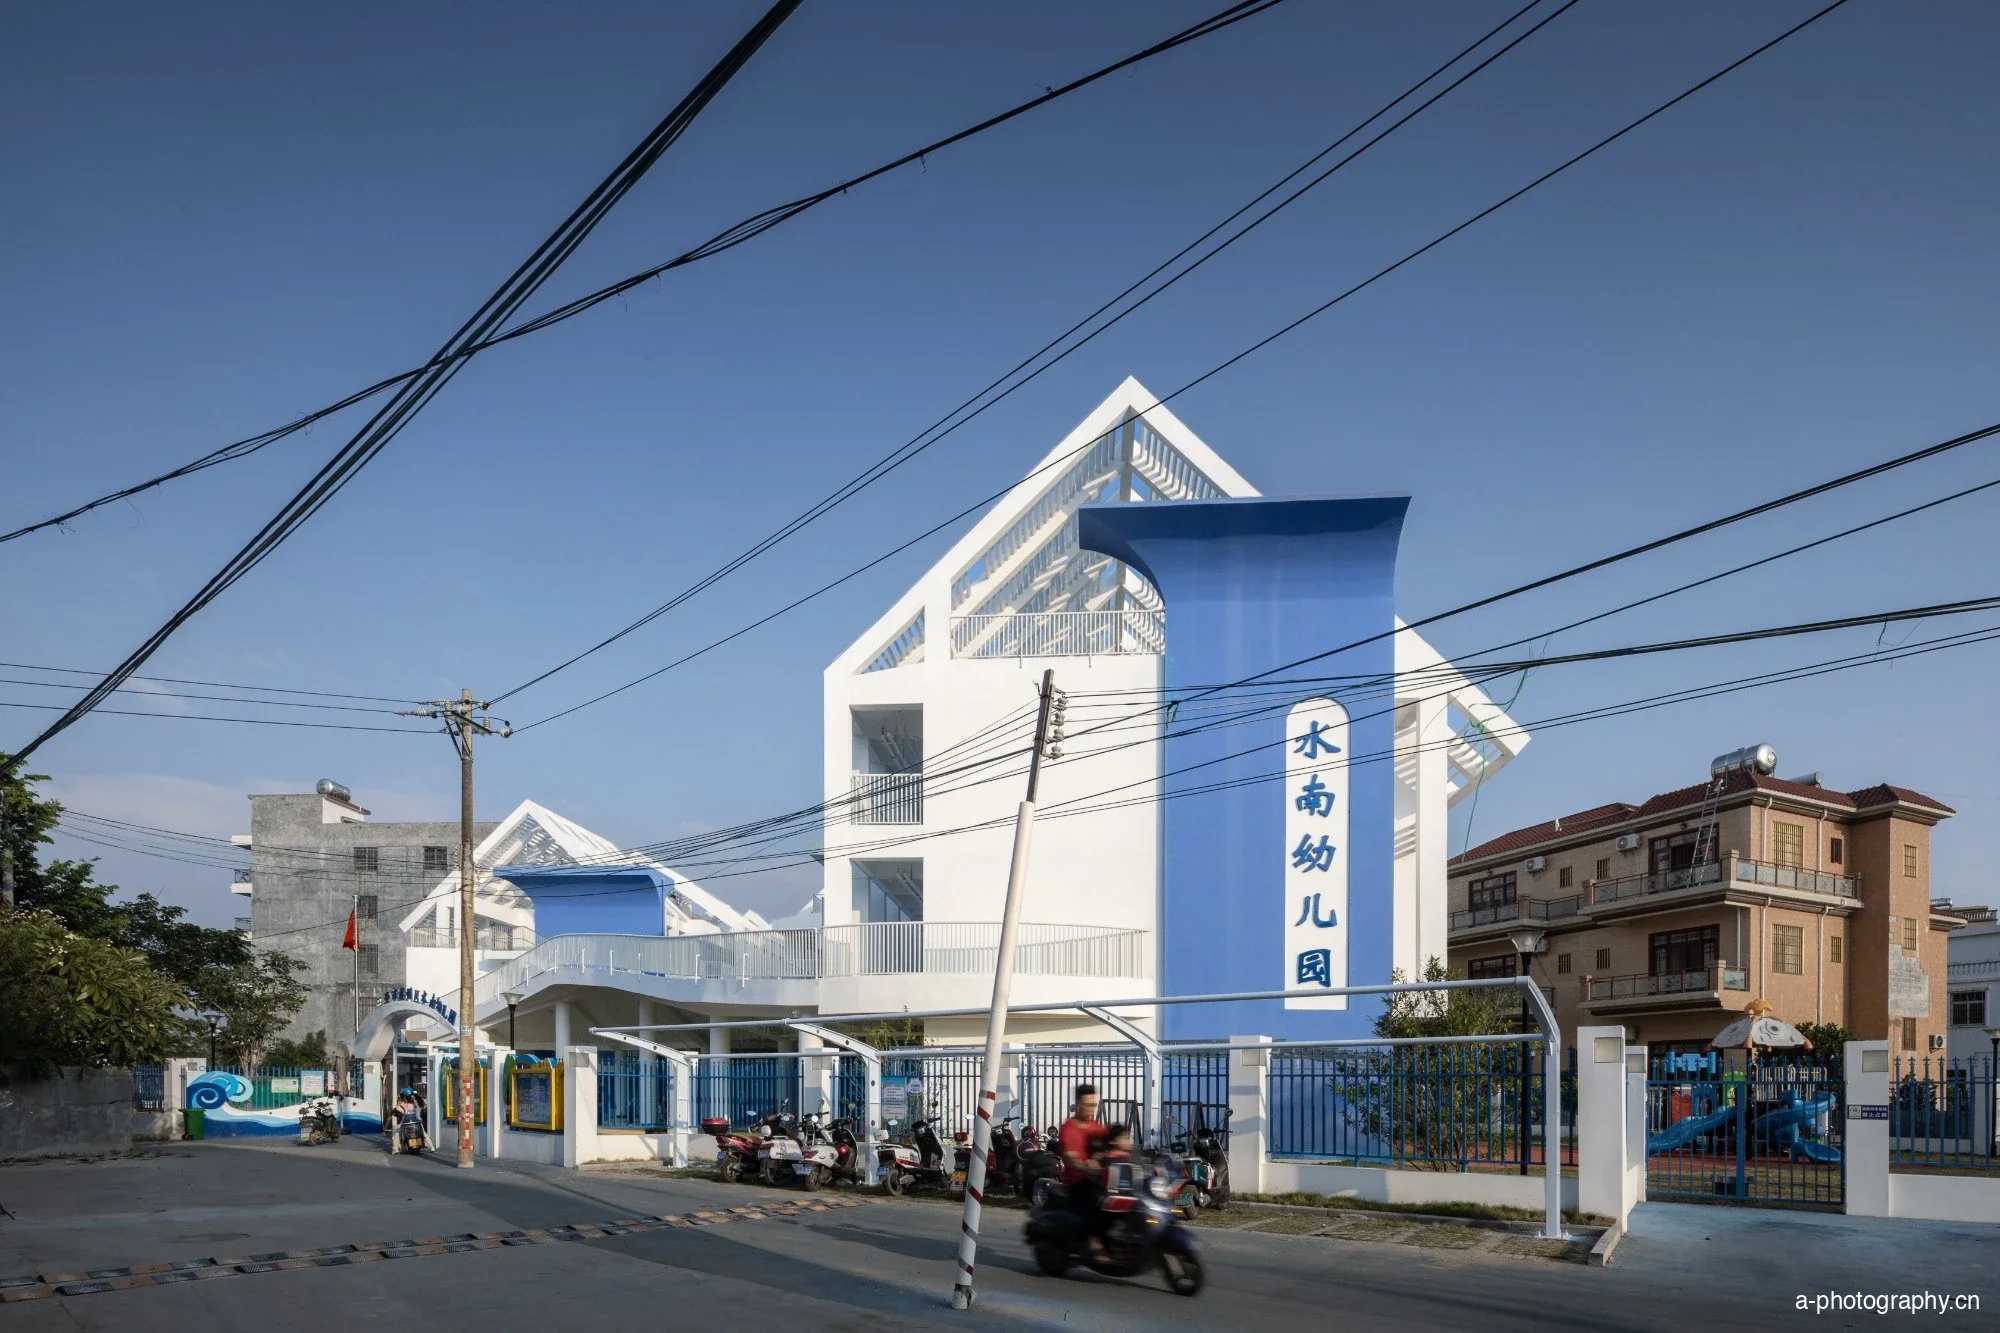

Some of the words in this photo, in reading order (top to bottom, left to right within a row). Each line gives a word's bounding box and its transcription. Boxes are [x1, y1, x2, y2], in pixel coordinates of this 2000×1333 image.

[1292, 720, 1341, 988] 水南幼儿园
